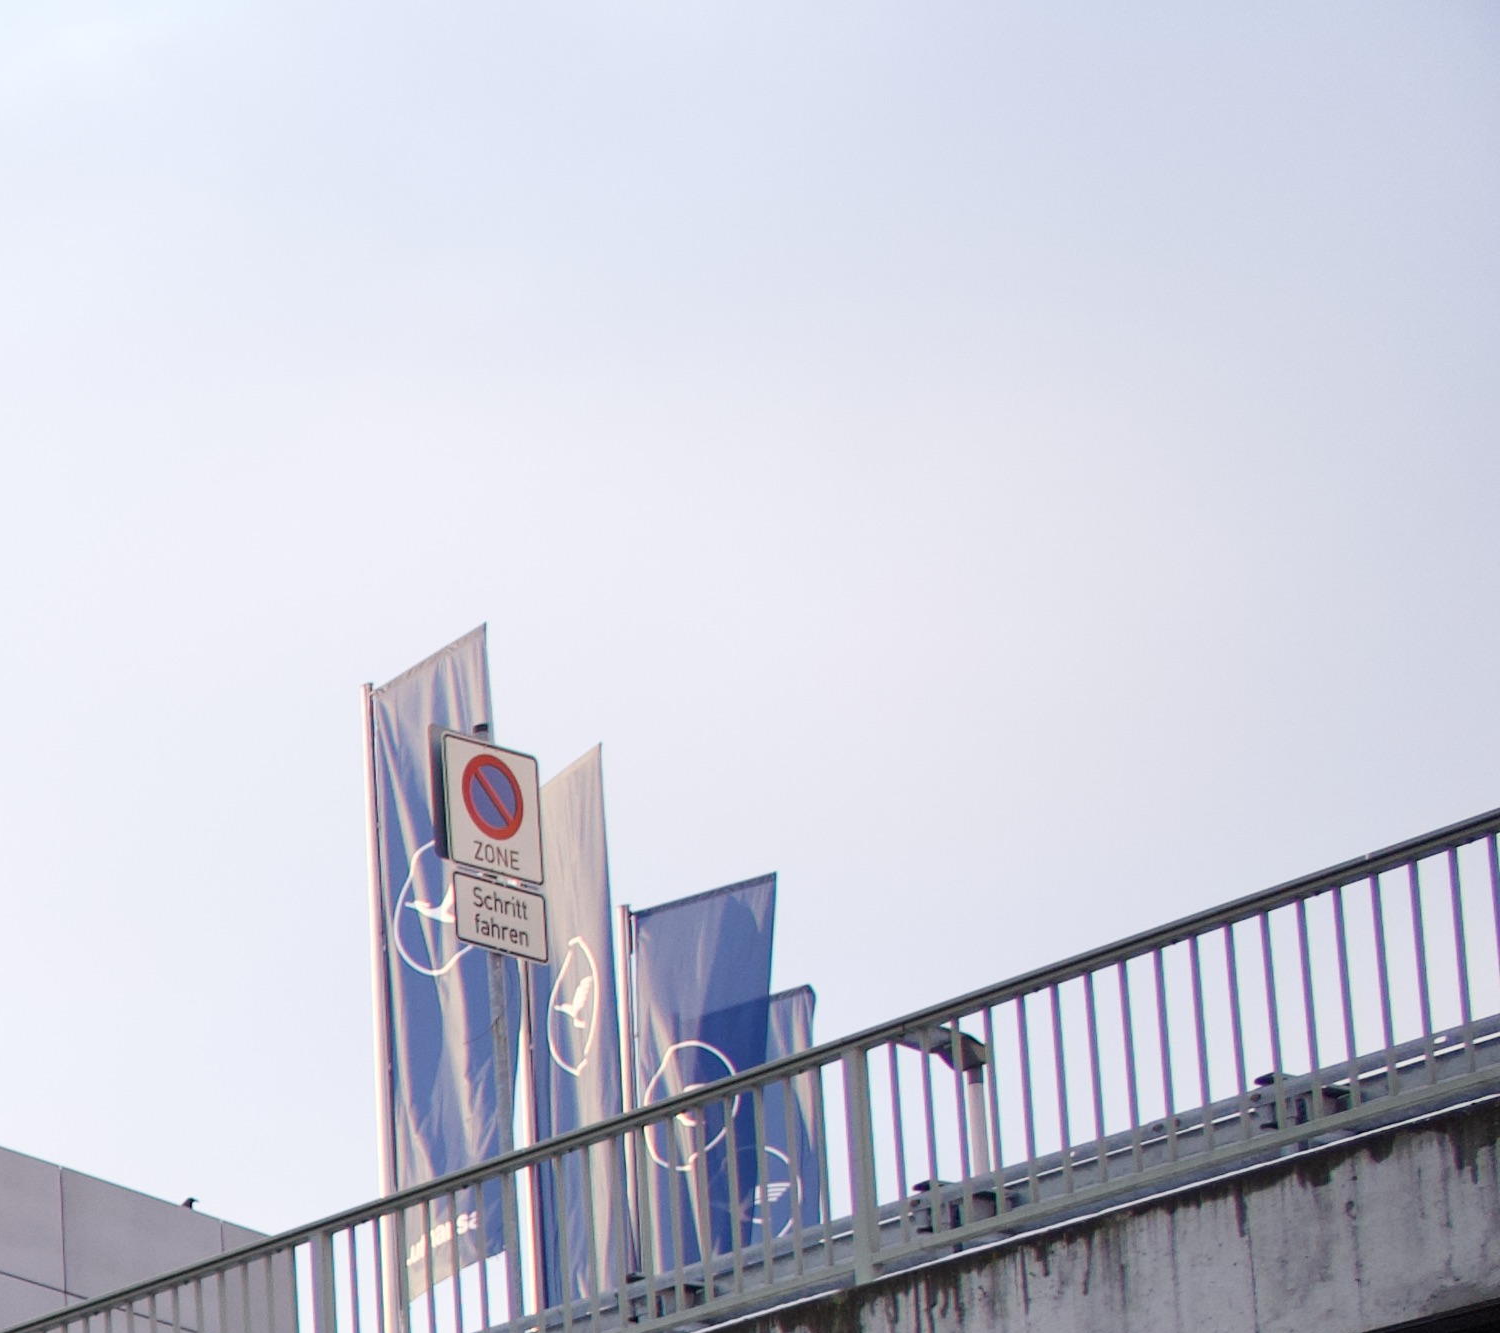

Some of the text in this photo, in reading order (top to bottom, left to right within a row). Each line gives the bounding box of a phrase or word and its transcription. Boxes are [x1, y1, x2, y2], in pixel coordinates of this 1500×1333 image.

[473, 840, 520, 871] ZONE
[473, 886, 528, 921] Schritt
[475, 913, 530, 947] fahren
